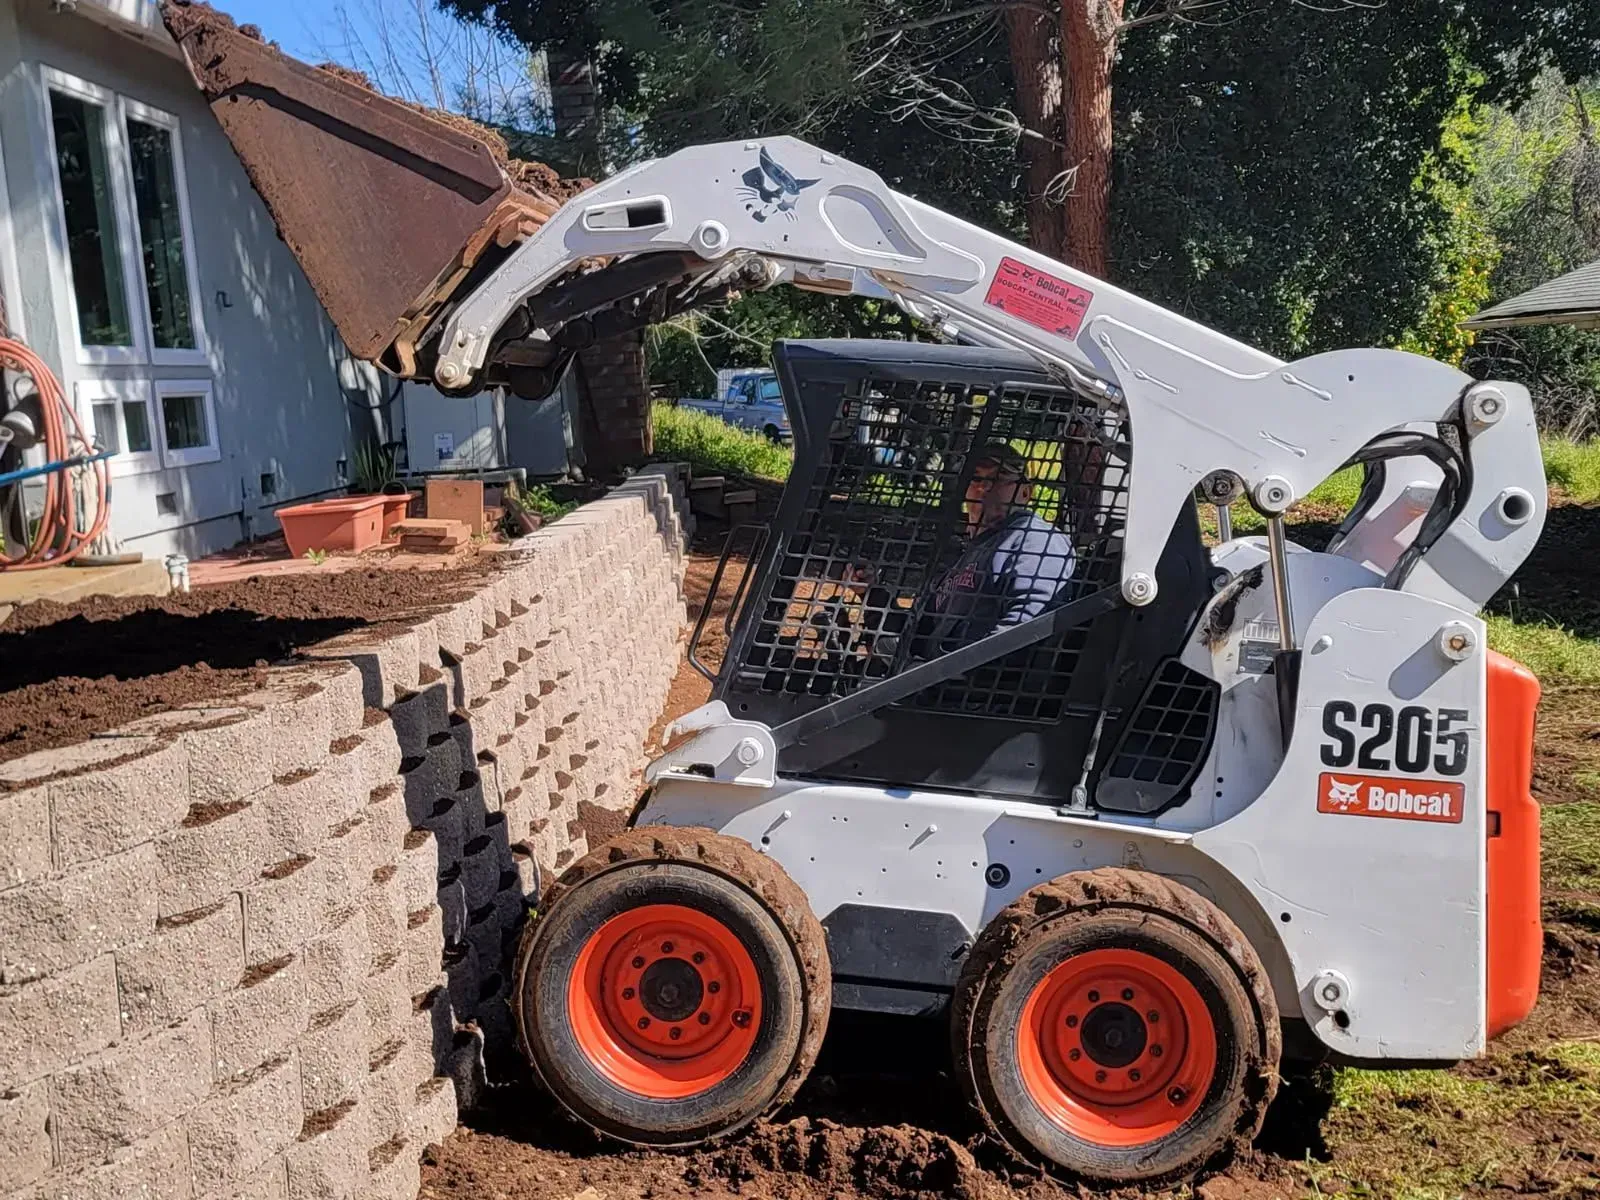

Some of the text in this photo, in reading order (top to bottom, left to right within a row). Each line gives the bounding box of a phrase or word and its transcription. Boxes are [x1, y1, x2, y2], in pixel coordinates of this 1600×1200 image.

[997, 277, 1027, 294] BOBCAT
[1036, 275, 1070, 299] Bobcat
[1320, 700, 1470, 776] S205
